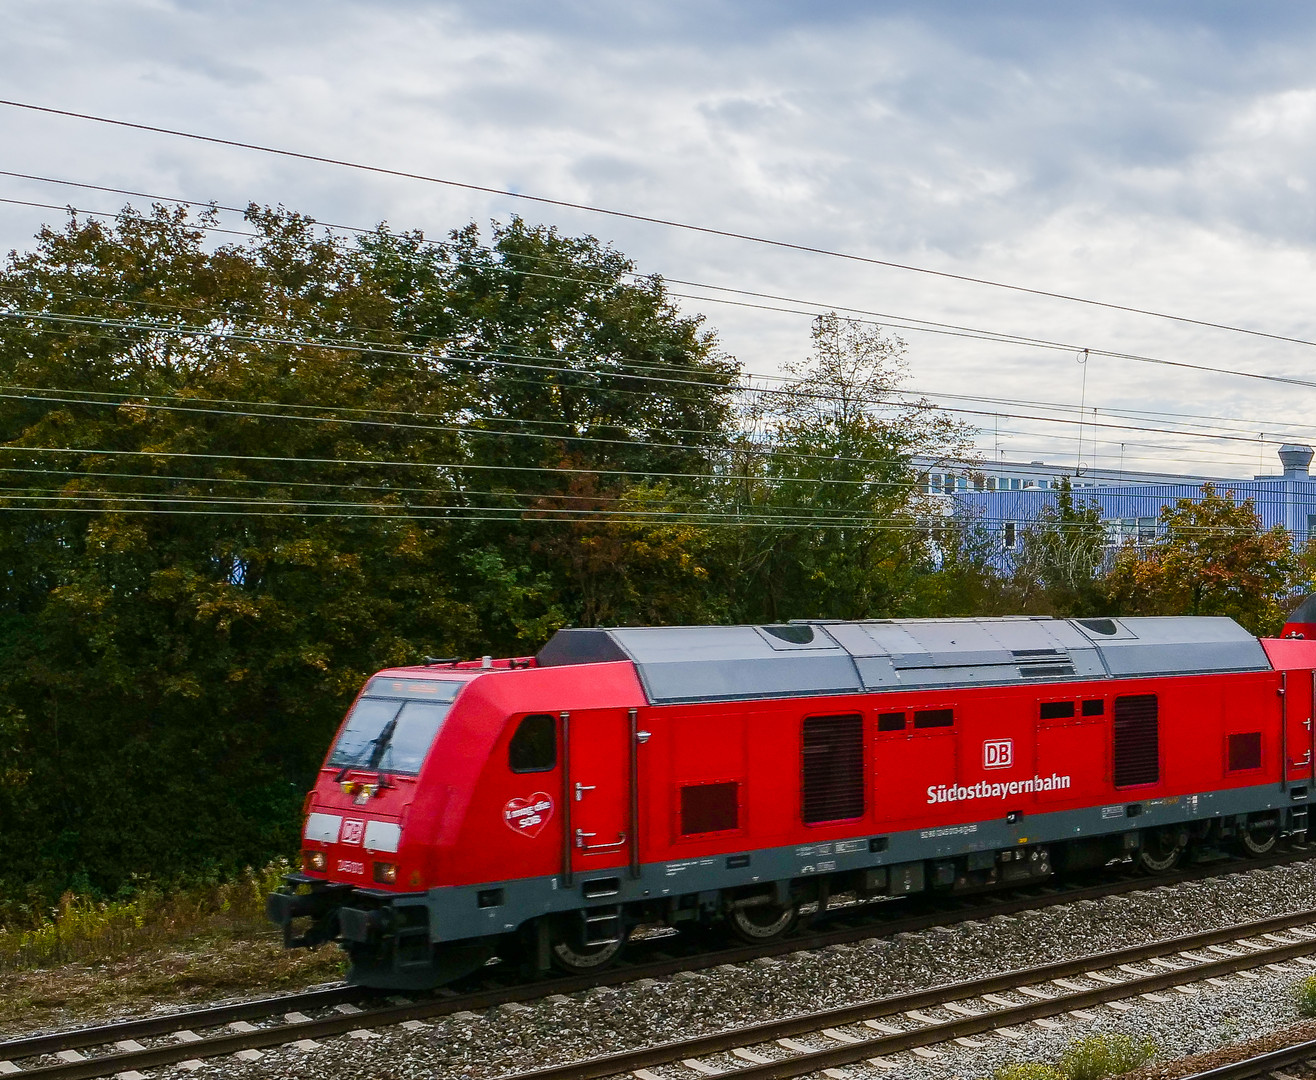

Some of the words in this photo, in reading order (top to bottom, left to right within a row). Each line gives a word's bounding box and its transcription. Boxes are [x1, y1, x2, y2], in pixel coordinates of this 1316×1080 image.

[985, 743, 1012, 766] DB
[926, 773, 1071, 804] Südostbayernbahn
[342, 821, 364, 843] DB
[519, 815, 542, 829] SOB
